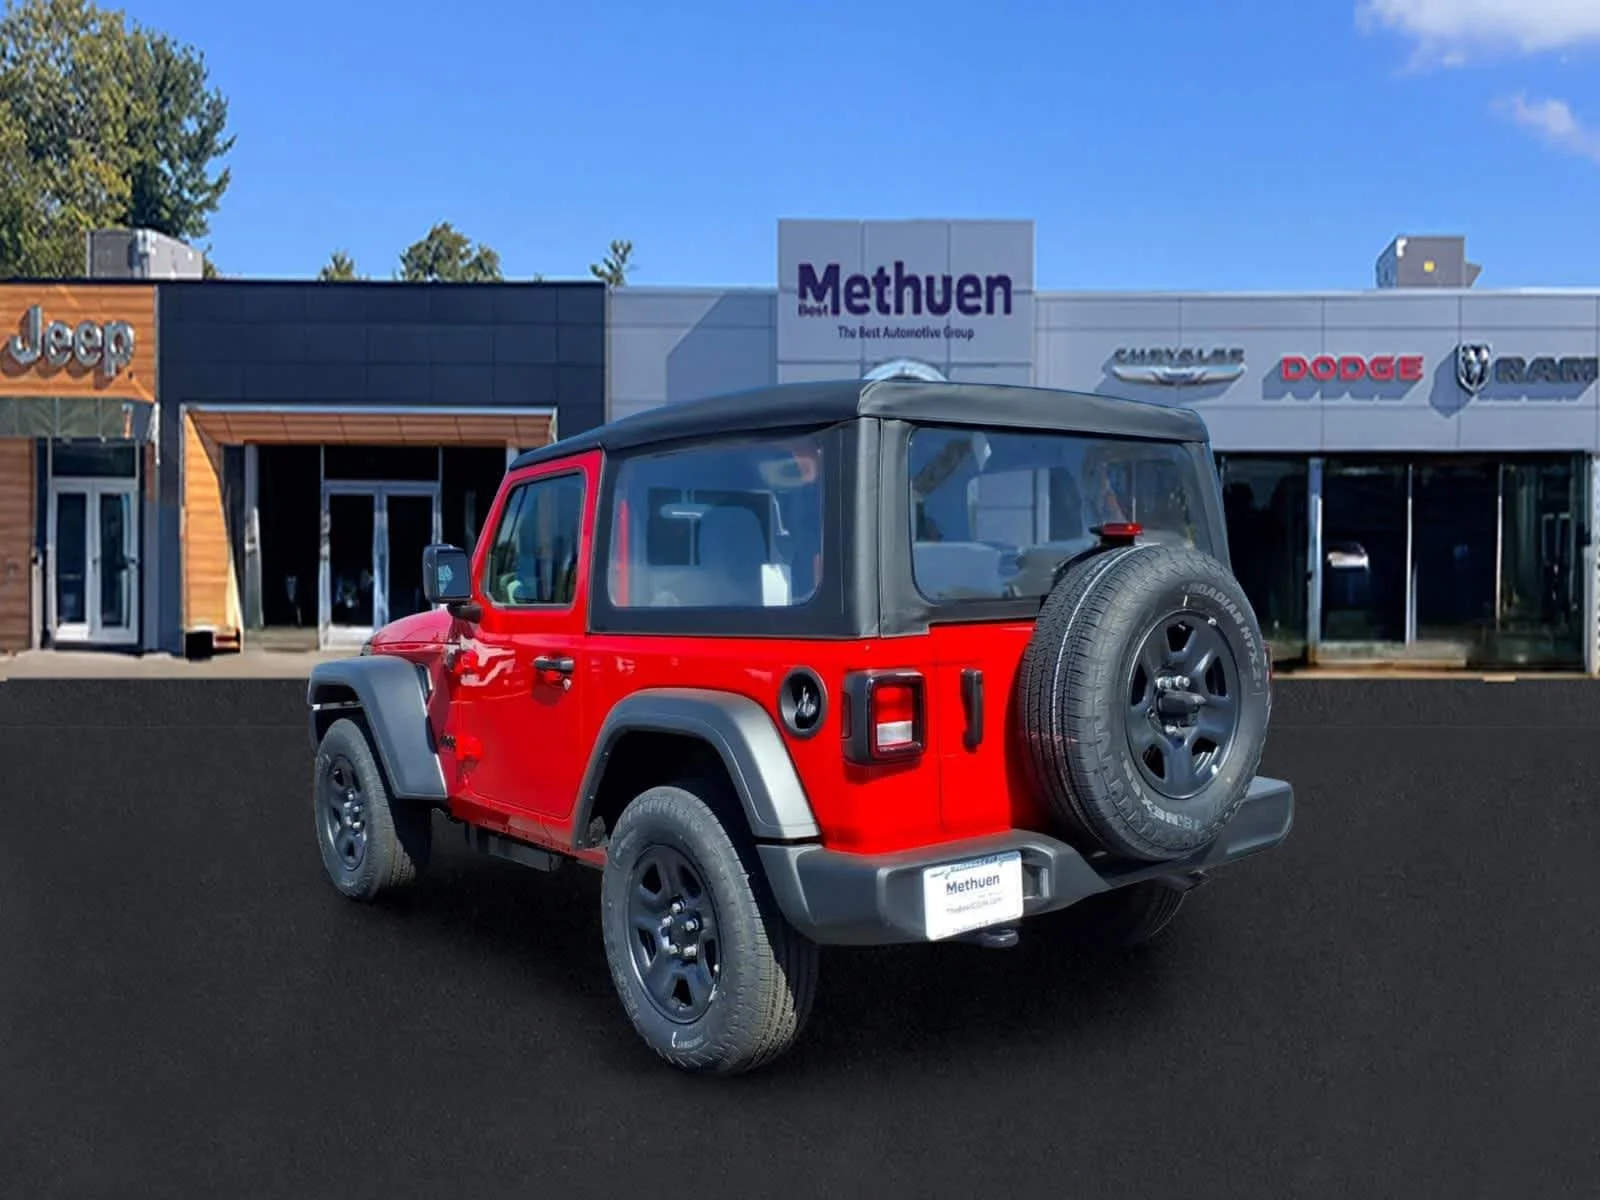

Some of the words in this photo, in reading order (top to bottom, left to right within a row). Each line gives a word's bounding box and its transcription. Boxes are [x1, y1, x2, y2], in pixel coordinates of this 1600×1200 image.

[798, 260, 1012, 315] Methuen
[9, 304, 135, 377] Jeep
[838, 325, 857, 338] The
[859, 325, 880, 338] Best
[882, 325, 941, 339] Automotive
[943, 325, 974, 341] Group
[1114, 347, 1244, 364] CHRYSLER
[1281, 355, 1424, 382] DODGE
[1495, 356, 1598, 384] RAM
[946, 874, 1000, 895] Methuen
